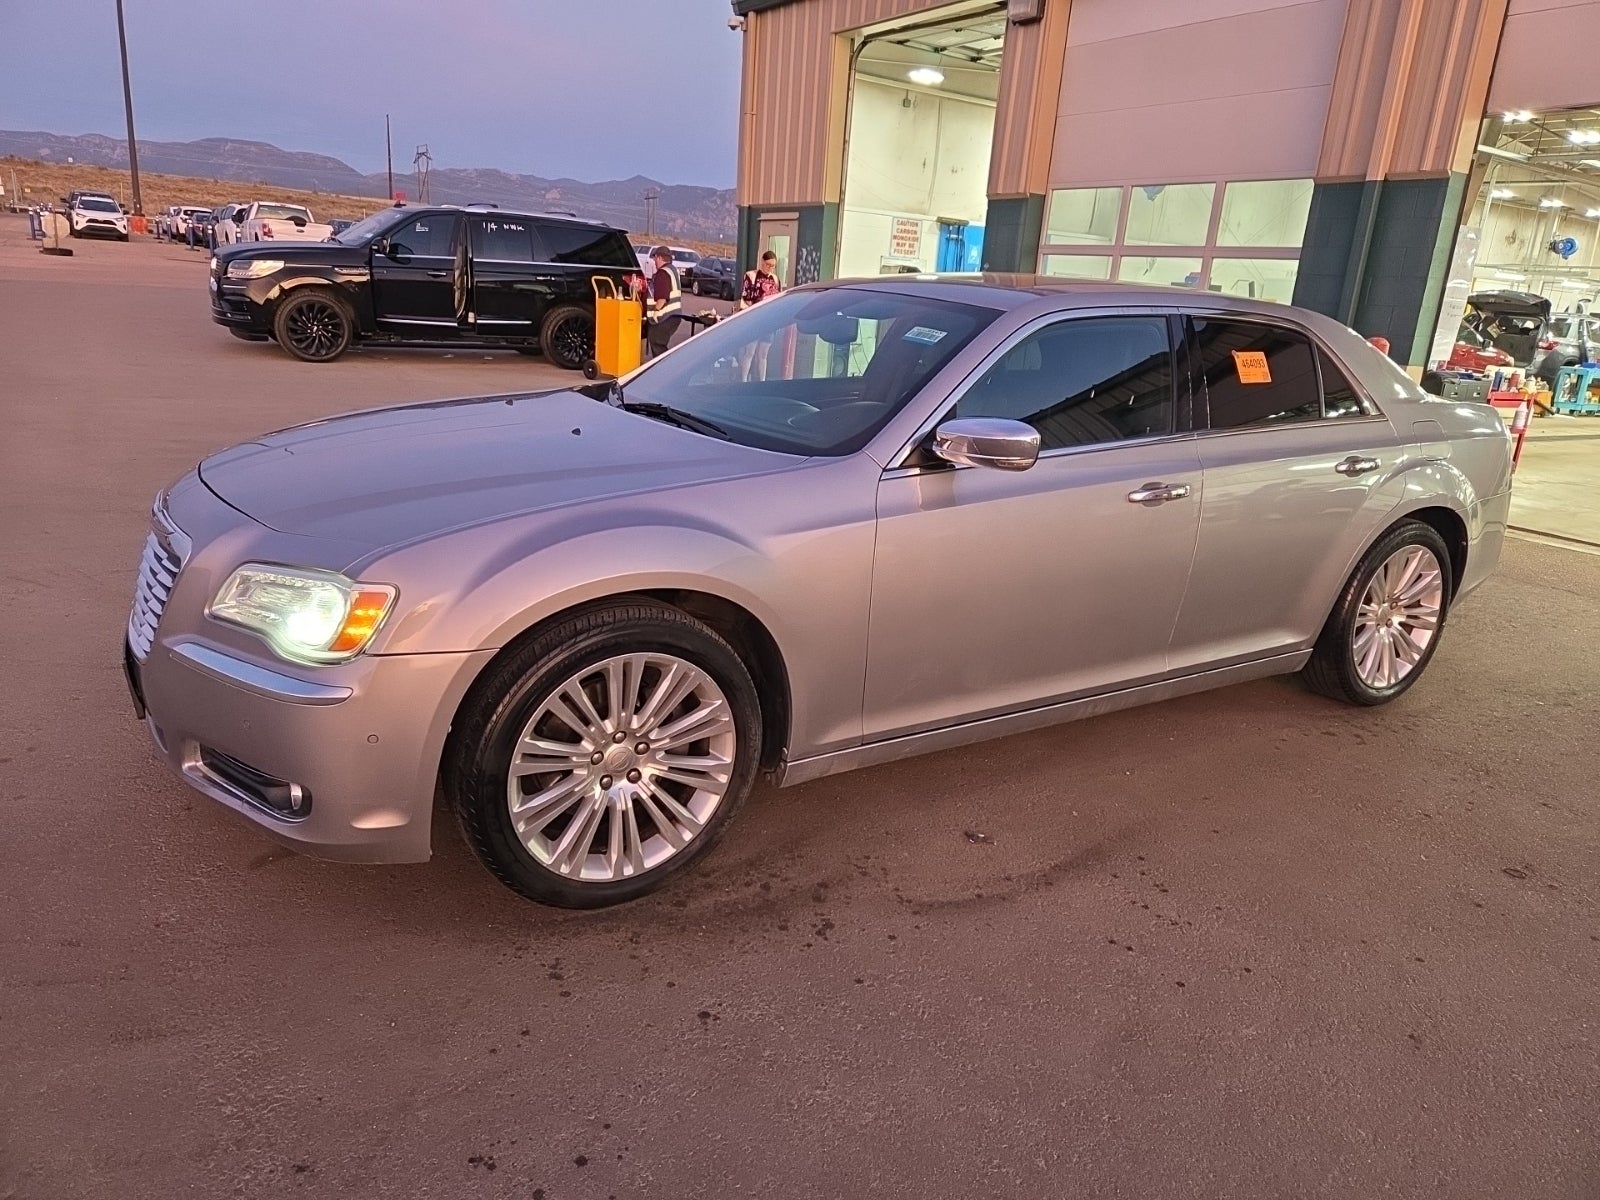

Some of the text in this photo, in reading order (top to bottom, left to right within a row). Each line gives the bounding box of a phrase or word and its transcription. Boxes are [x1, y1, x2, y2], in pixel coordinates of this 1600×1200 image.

[896, 219, 919, 228] CAUTION
[896, 228, 918, 236] CARBON
[892, 234, 919, 243] MONOXIDE
